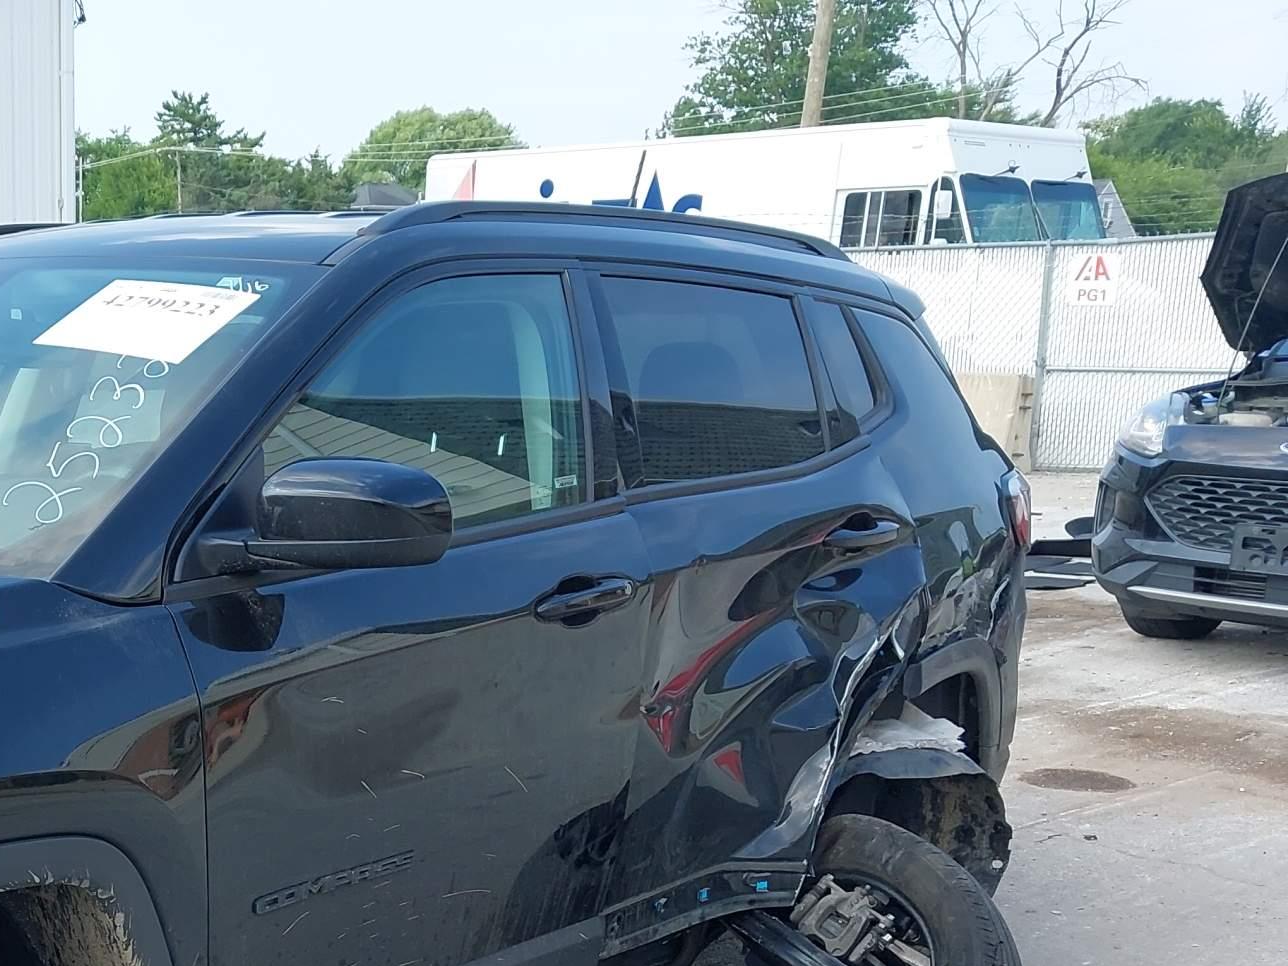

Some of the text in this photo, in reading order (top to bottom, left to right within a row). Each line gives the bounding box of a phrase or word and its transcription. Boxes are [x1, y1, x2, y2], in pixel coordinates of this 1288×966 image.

[102, 294, 220, 317] 42799223
[1077, 288, 1106, 302] PG1
[251, 849, 415, 915] COMPASS
